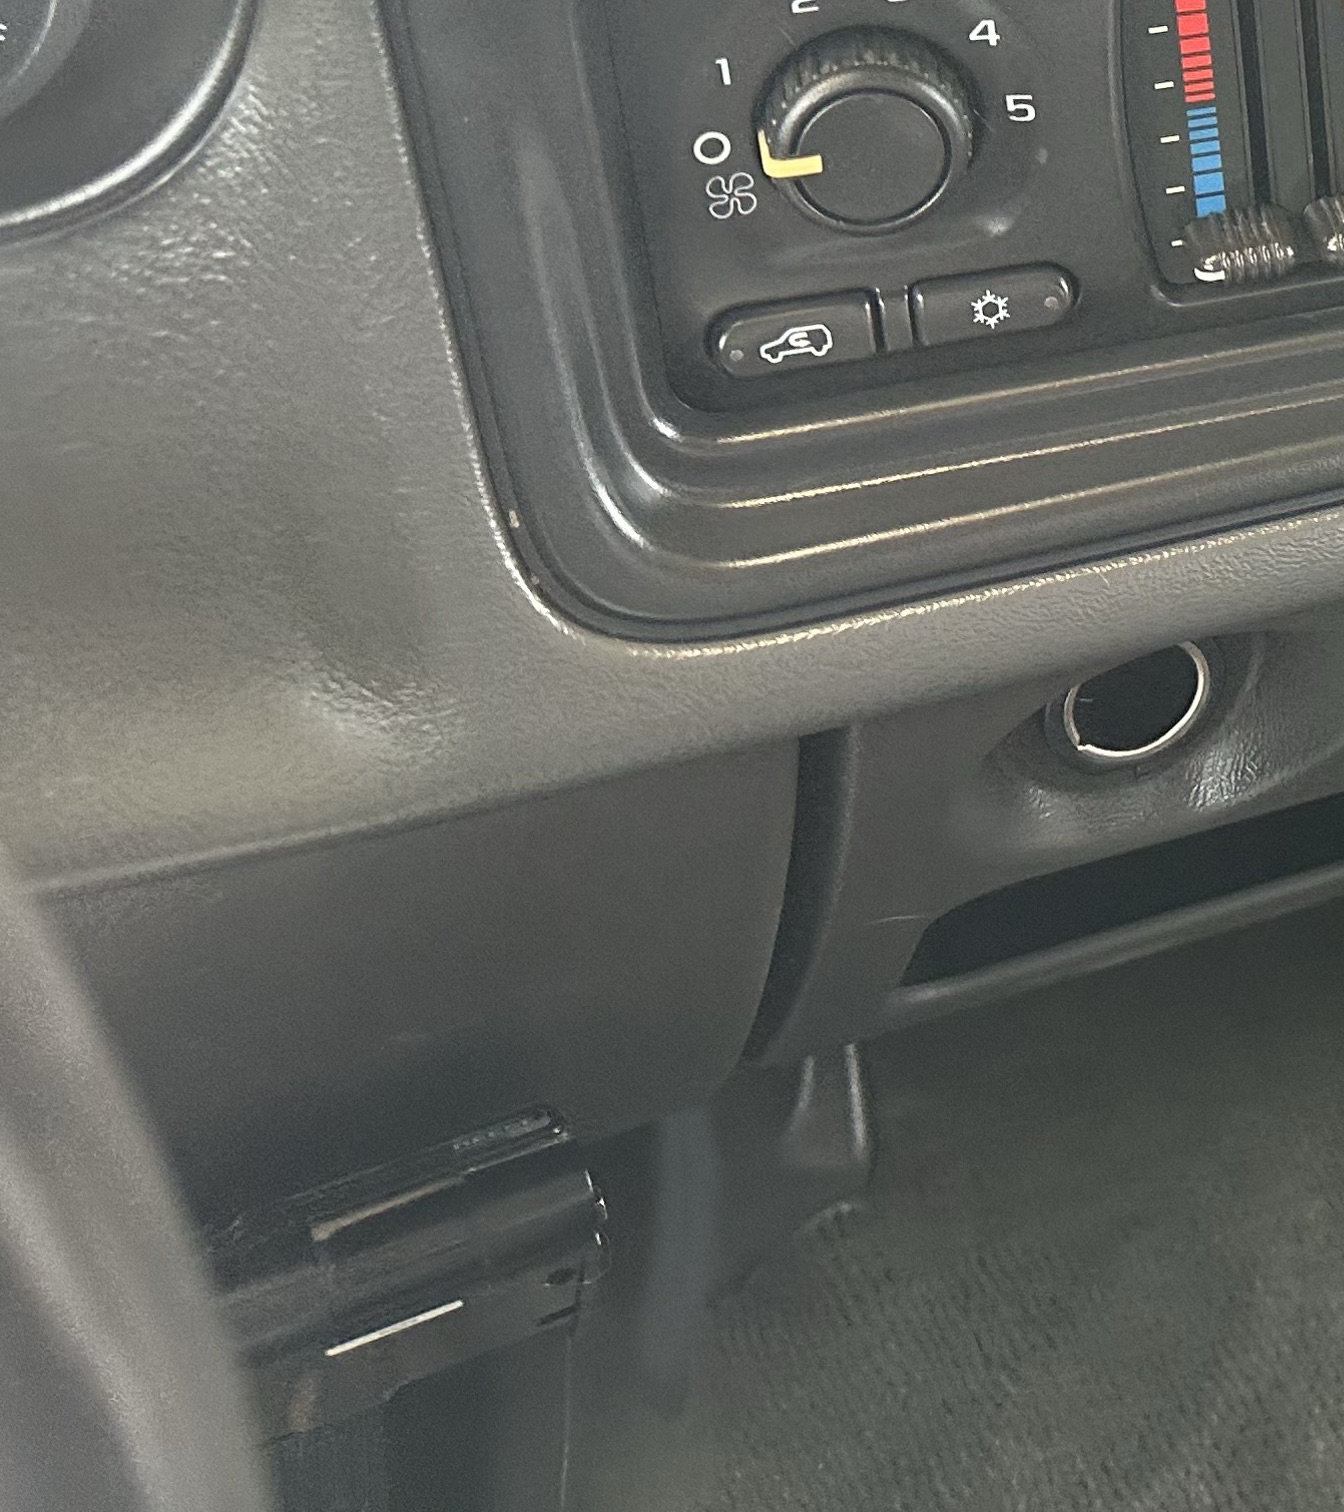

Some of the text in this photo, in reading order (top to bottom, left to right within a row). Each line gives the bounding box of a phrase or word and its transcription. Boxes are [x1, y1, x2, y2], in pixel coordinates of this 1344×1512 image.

[968, 19, 1001, 47] 4
[715, 57, 732, 86] 1
[1005, 94, 1036, 122] 5
